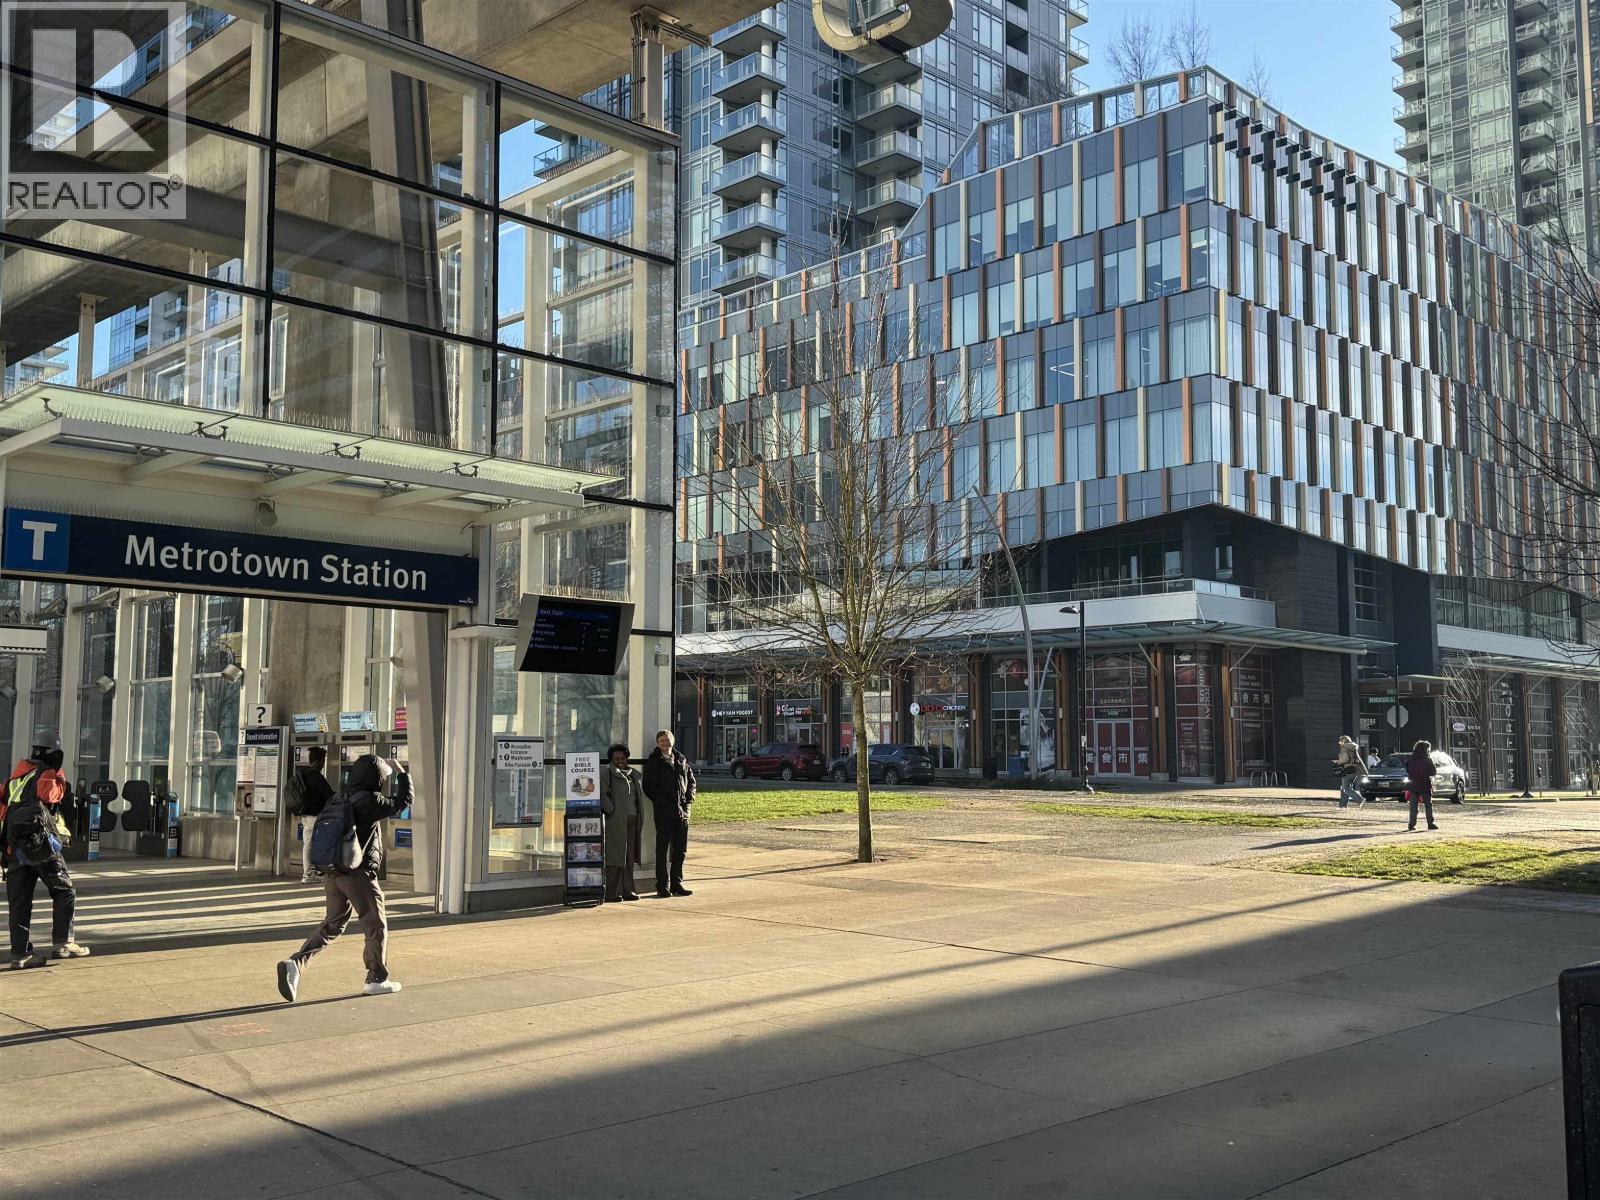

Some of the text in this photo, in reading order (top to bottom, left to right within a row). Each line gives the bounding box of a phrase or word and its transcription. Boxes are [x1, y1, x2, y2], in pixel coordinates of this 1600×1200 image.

[22, 520, 57, 561] T
[124, 534, 427, 591] Metrotown Station
[246, 733, 257, 741] Transit
